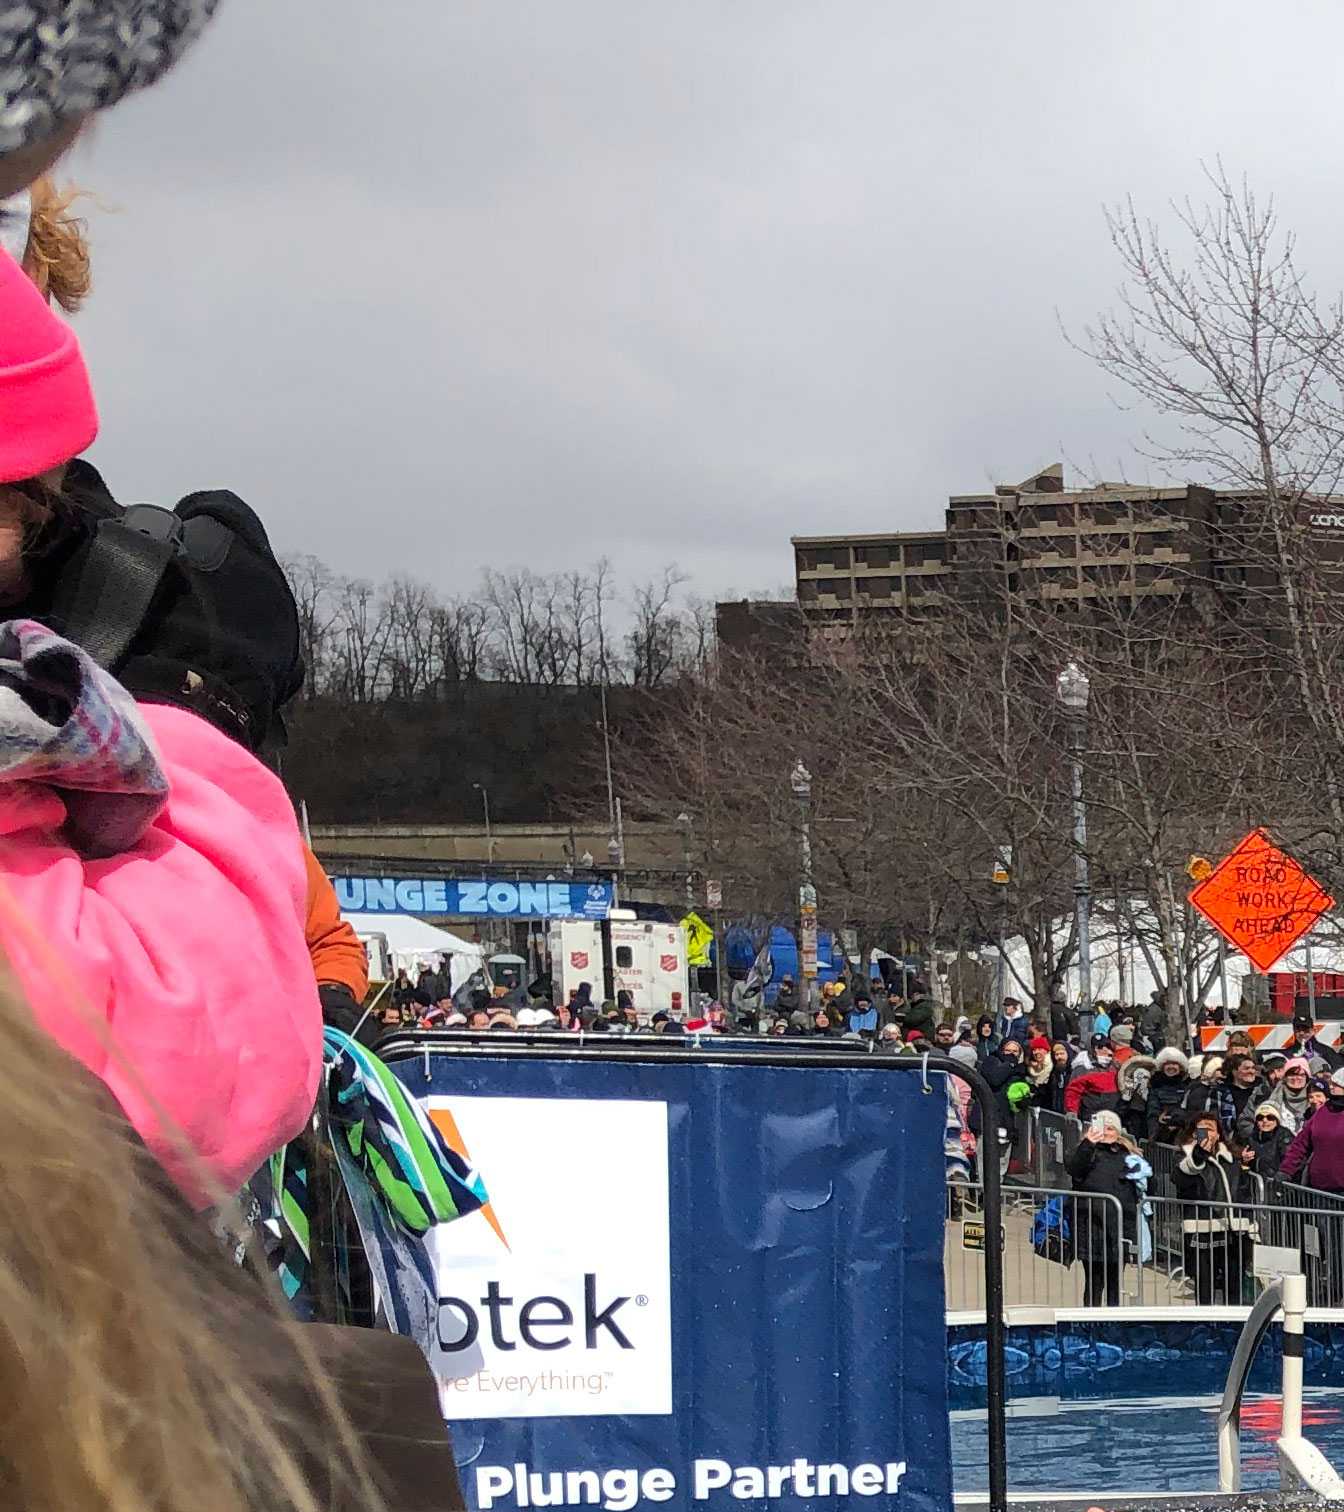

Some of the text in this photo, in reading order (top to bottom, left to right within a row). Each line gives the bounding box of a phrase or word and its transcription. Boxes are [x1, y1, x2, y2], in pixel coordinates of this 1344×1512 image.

[1237, 867, 1287, 883] ROAD
[458, 882, 572, 914] ZONE
[1237, 892, 1291, 909] WORK
[1233, 918, 1295, 934] AHEAD
[475, 1458, 907, 1512] Plunge Partner
